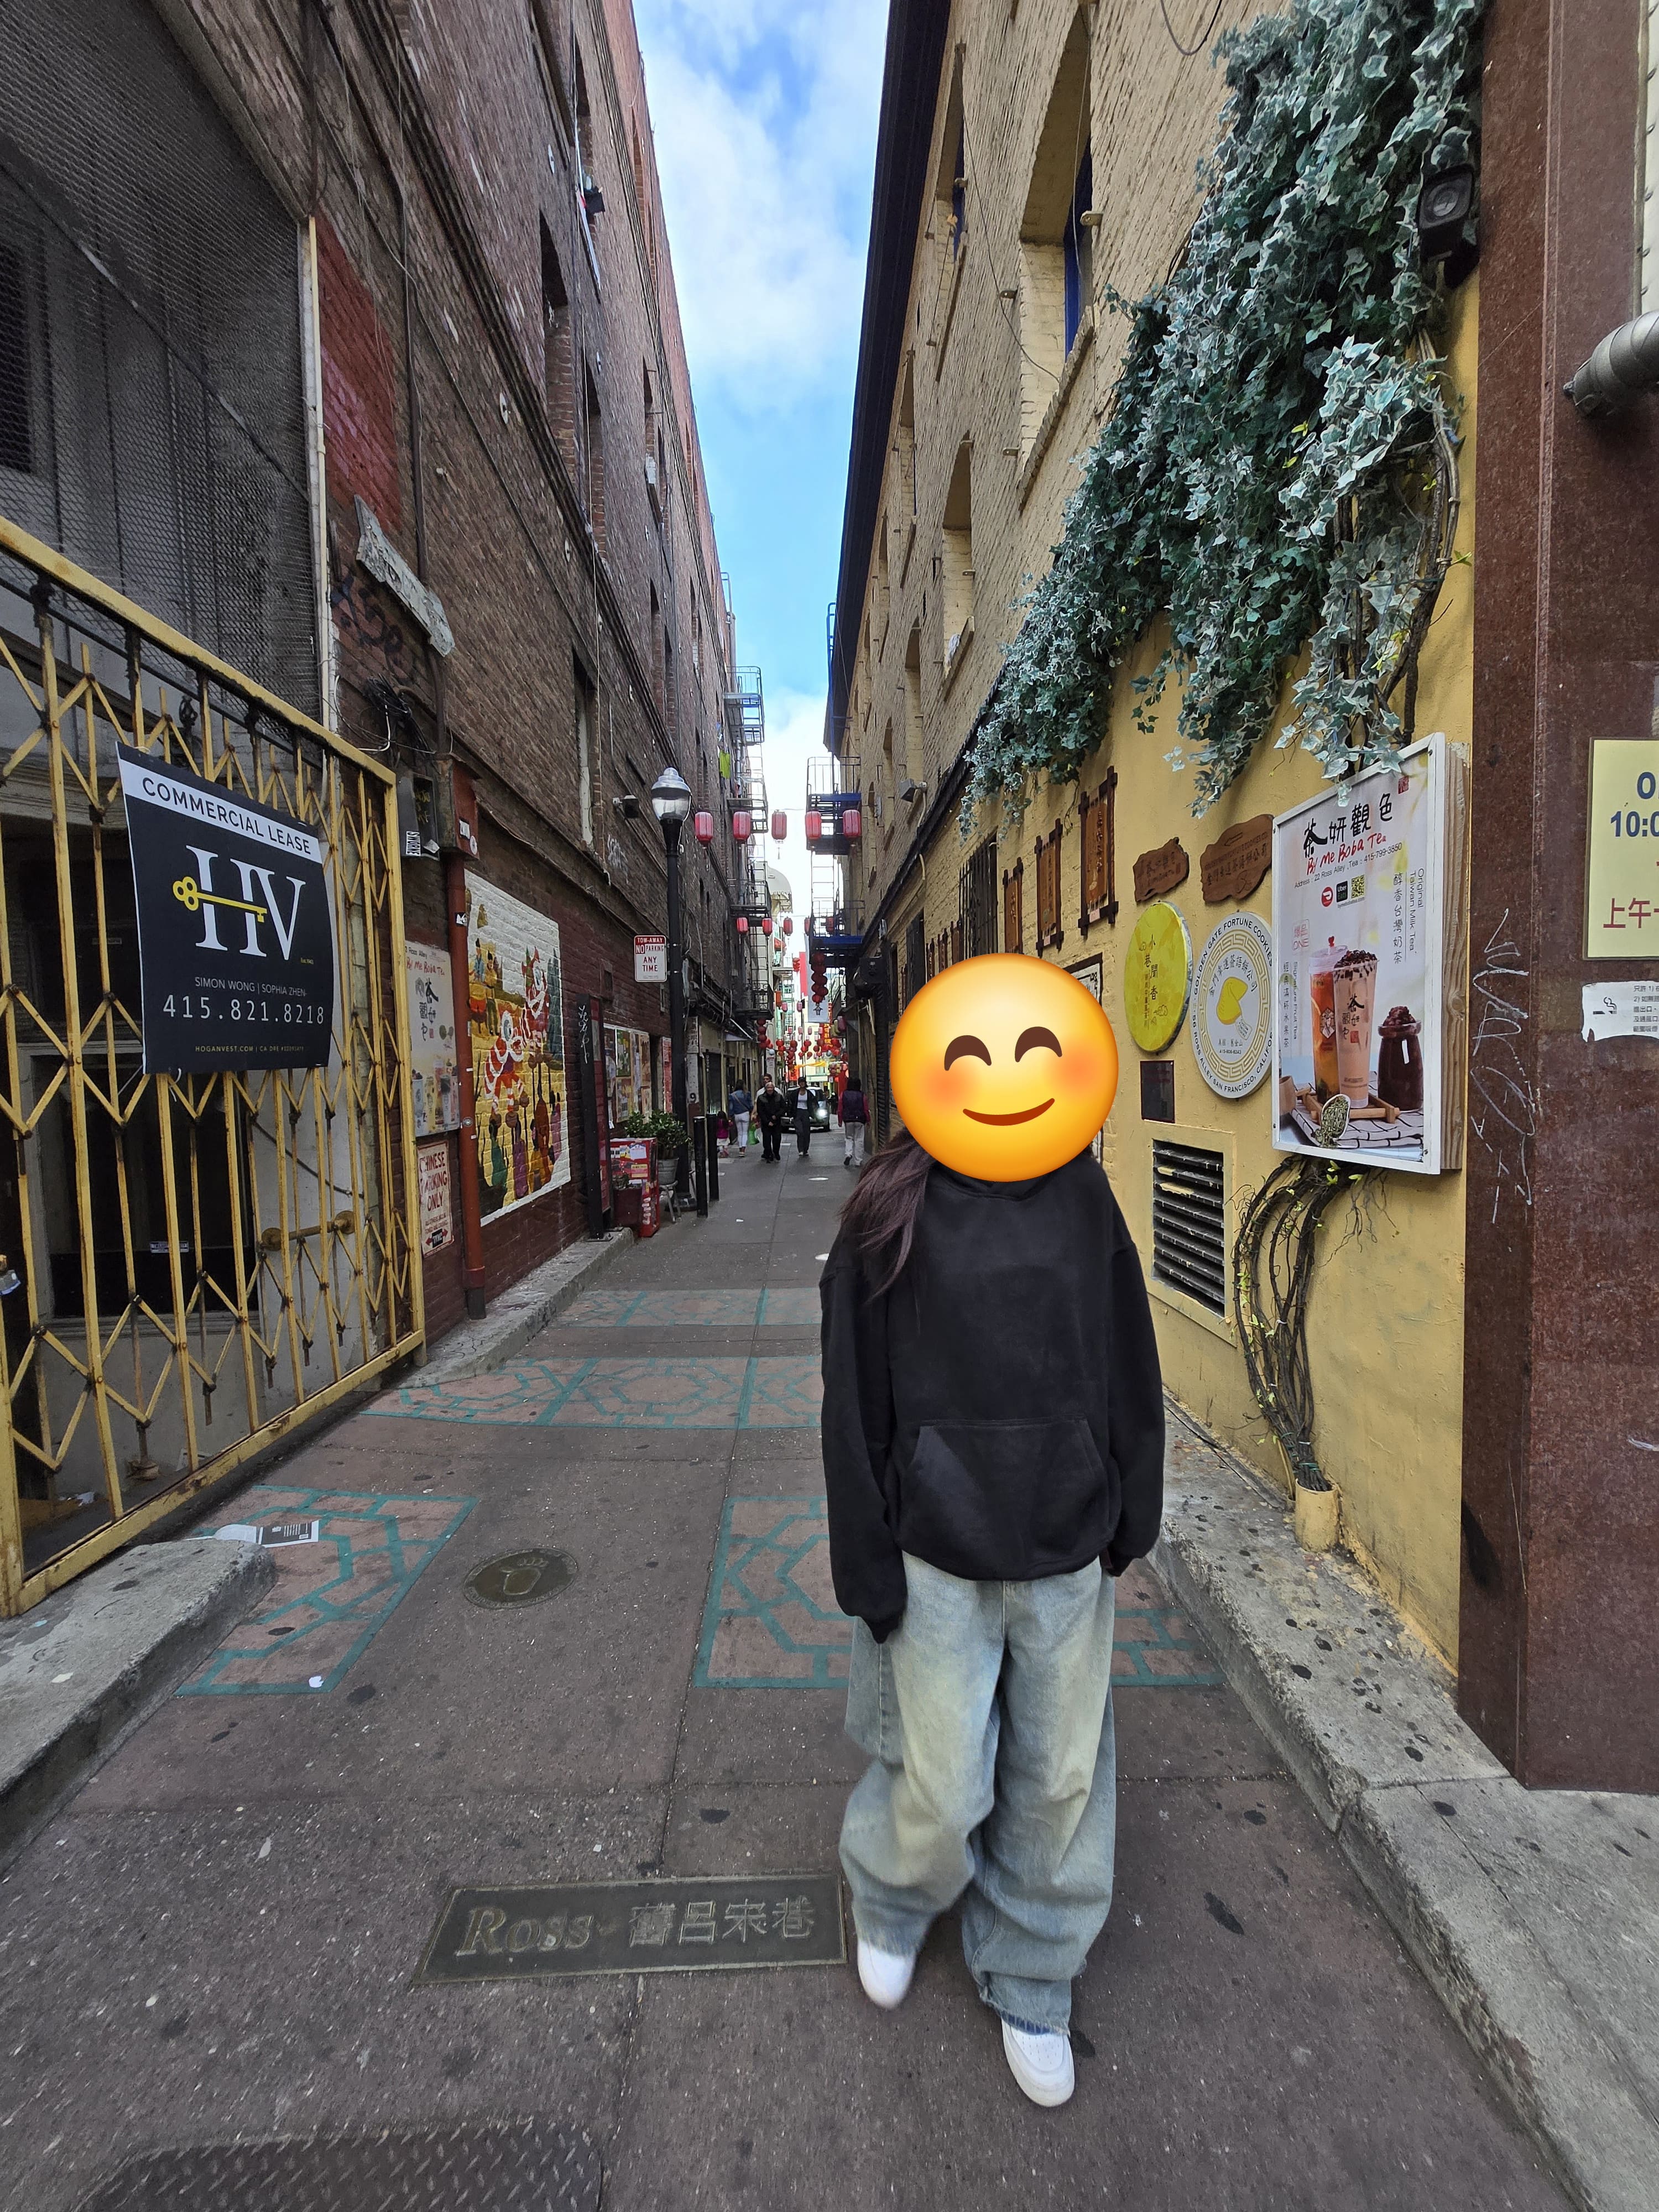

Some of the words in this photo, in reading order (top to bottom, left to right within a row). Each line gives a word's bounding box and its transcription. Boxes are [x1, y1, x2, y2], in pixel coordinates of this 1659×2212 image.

[143, 776, 264, 837] COMMERCIAL
[268, 824, 311, 855] LEASE
[1320, 852, 1335, 868] Me
[1338, 839, 1364, 863] Boba
[1367, 832, 1386, 848] Tea
[1321, 870, 1332, 879] Ross
[1334, 865, 1345, 875] Alley
[636, 945, 644, 953] NO
[1194, 951, 1208, 995] GOLDEN
[1208, 927, 1222, 949] GATE
[1223, 917, 1253, 931] FORTUNE
[1253, 926, 1272, 967] COOKIES
[195, 977, 226, 989] SIMON
[227, 980, 255, 992] WONG
[262, 983, 288, 995] SOPHIA
[163, 994, 324, 1024] 415.821.8218
[1200, 1057, 1213, 1079] ALLEY
[1213, 1078, 1223, 1090] SAN
[419, 1151, 446, 1173] CHINESE
[427, 1191, 444, 1212] ONLY
